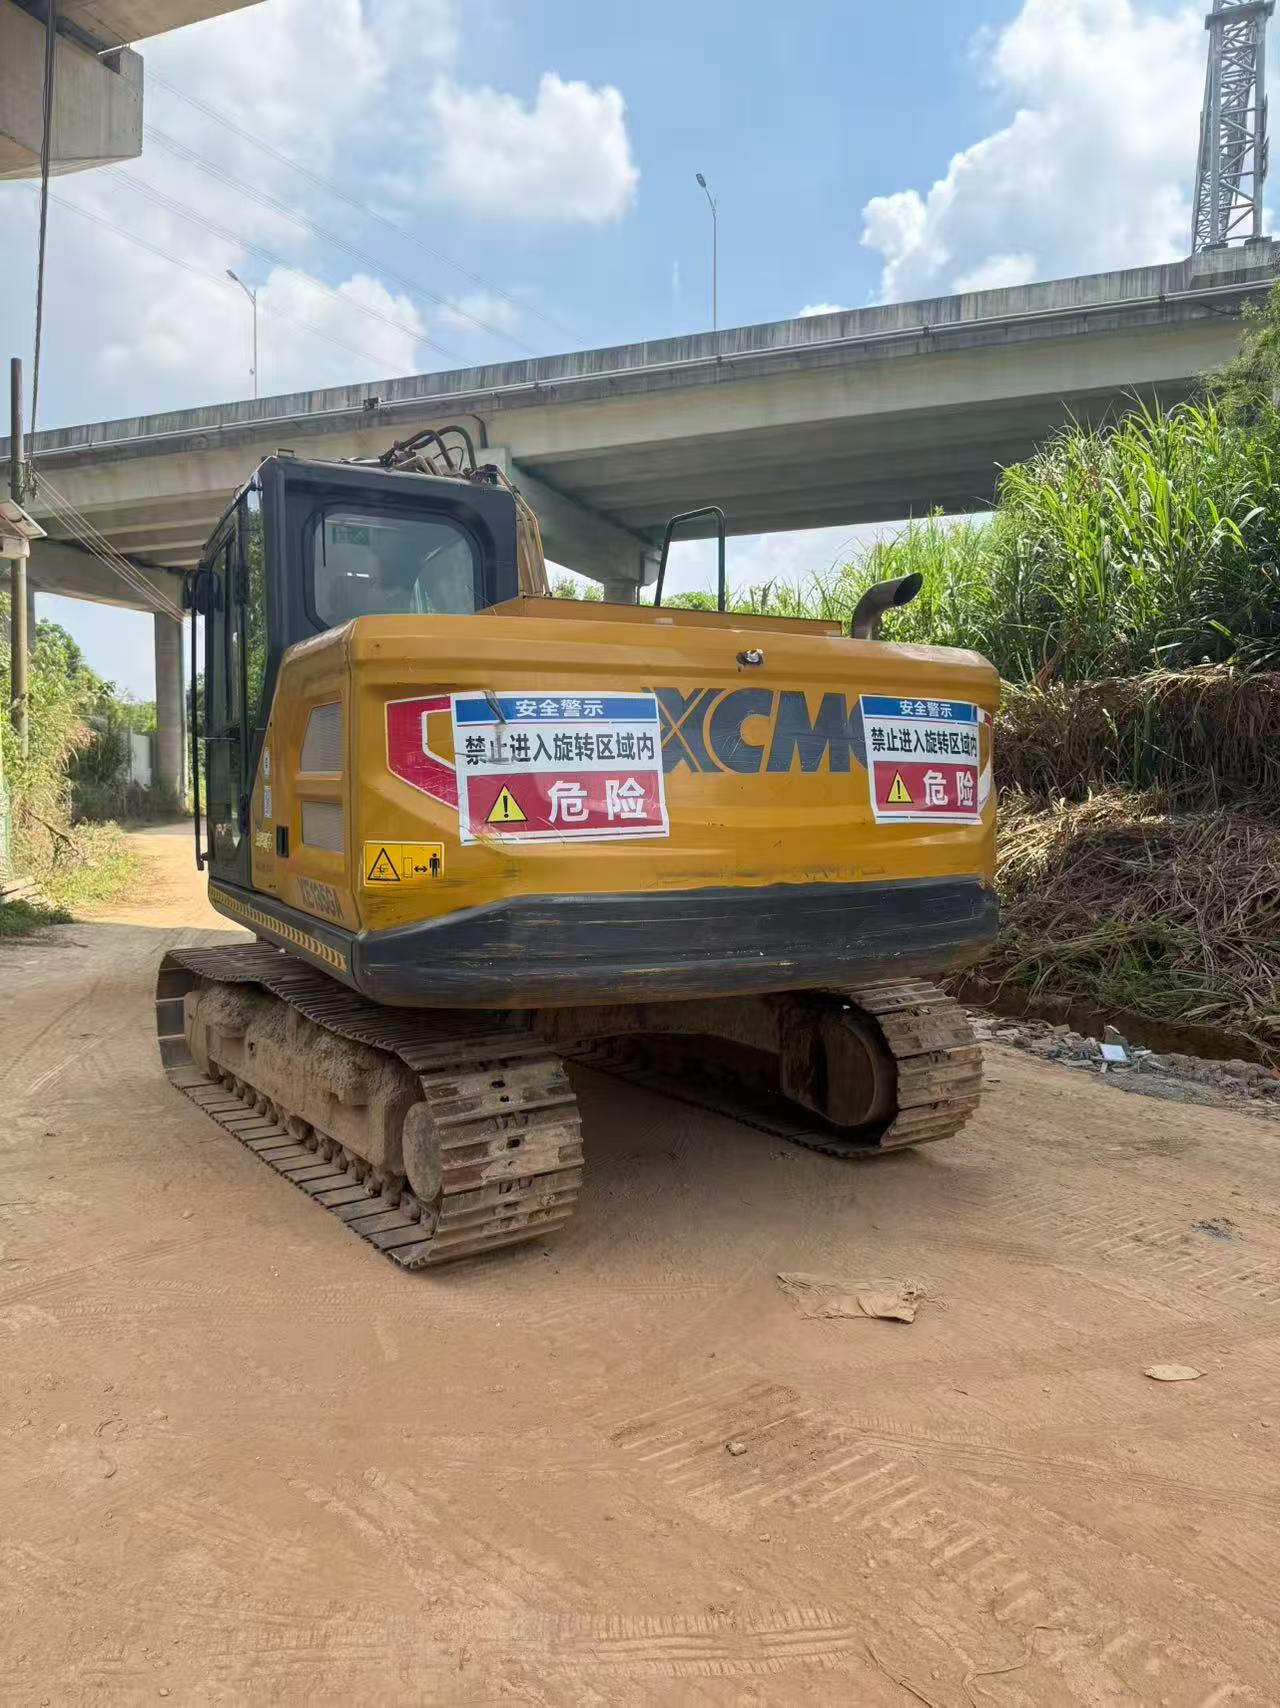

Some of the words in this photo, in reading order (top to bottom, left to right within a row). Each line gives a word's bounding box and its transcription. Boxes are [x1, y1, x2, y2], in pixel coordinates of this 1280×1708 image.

[515, 699, 604, 718] 安全警示
[899, 700, 953, 718] 安全警示
[641, 687, 868, 773] XCM
[871, 726, 977, 758] 禁止进入旋转区域内
[465, 732, 655, 765] 禁止进入旋转区域内
